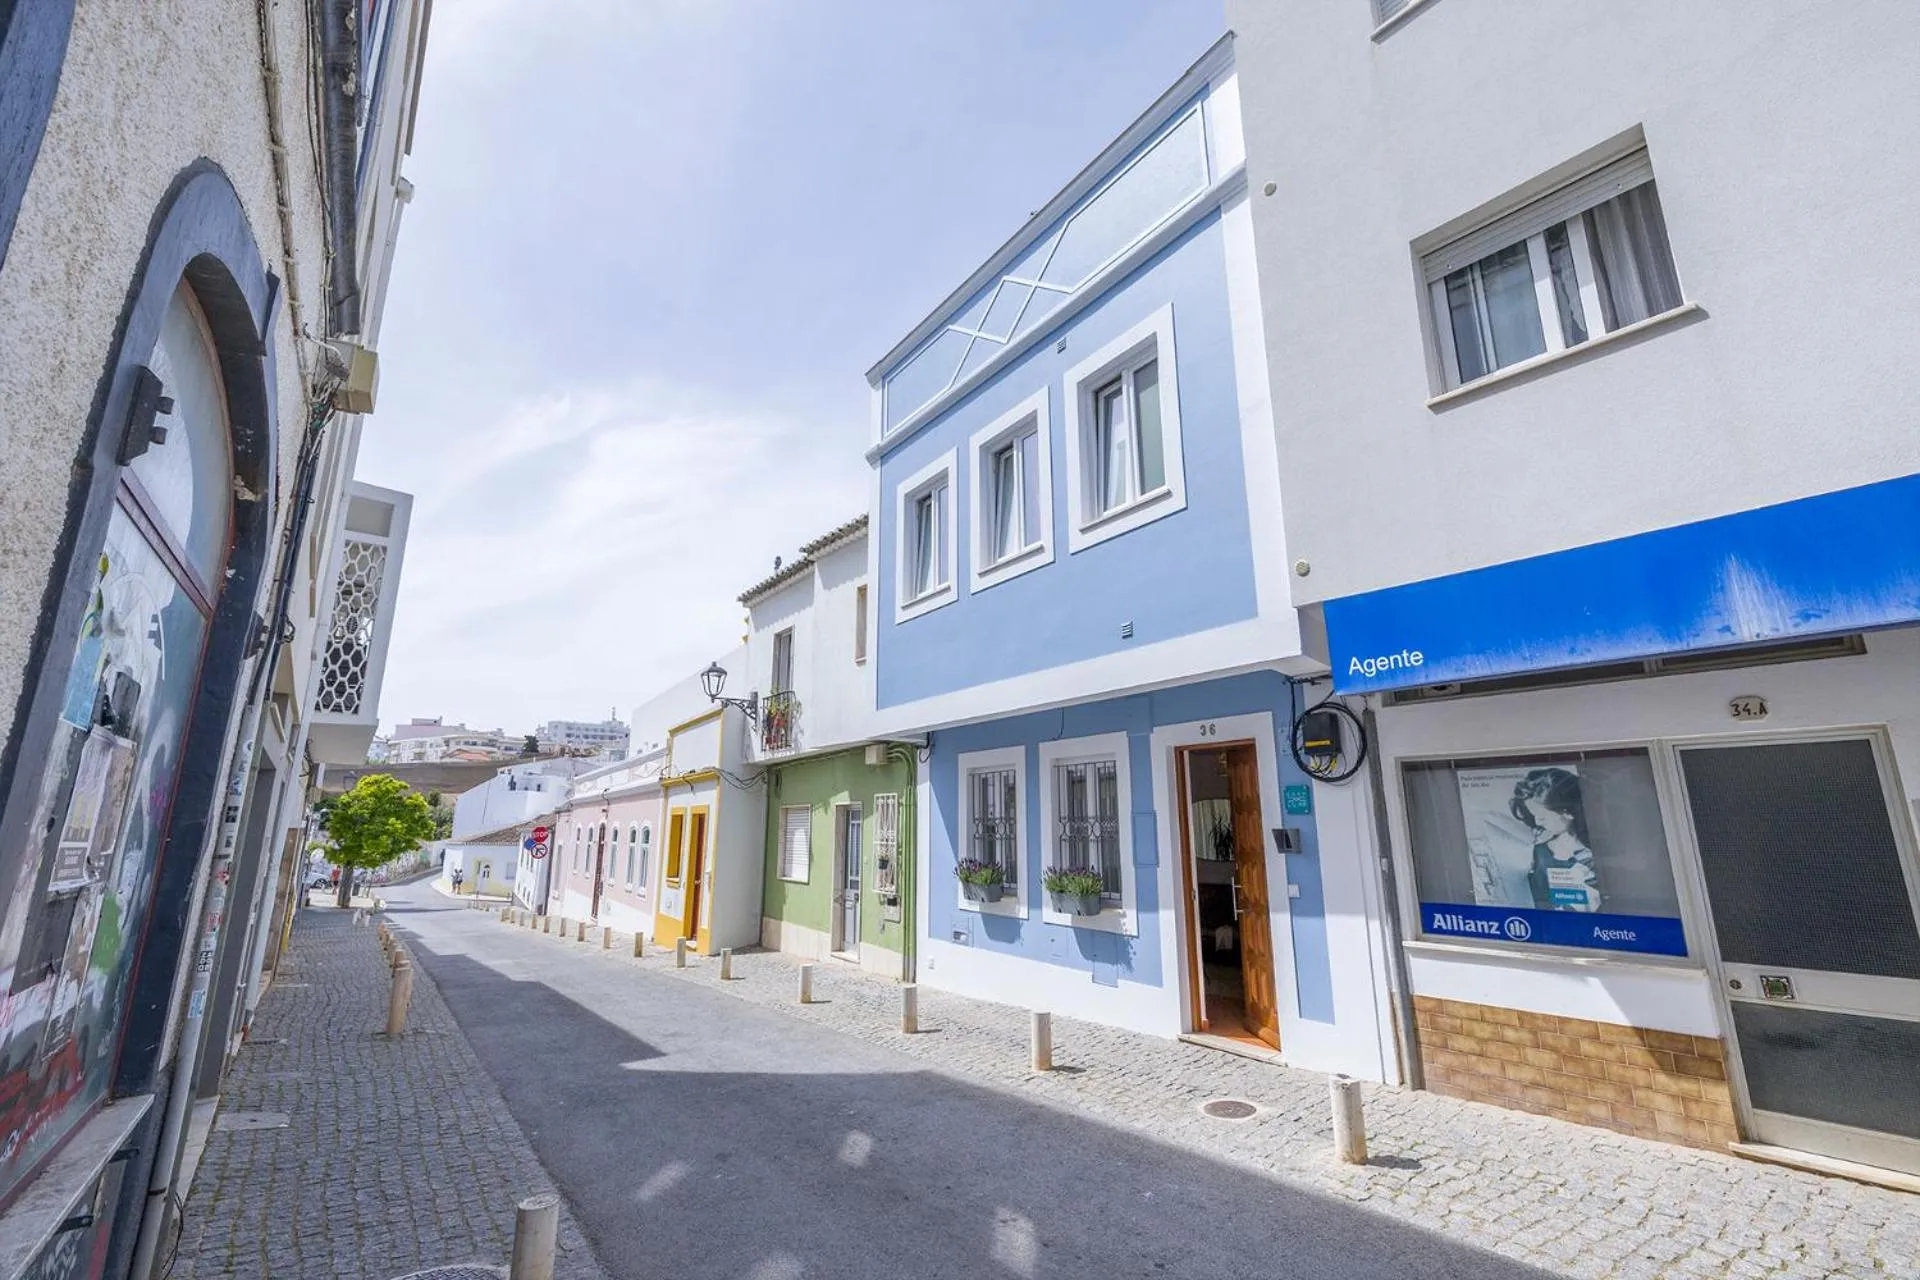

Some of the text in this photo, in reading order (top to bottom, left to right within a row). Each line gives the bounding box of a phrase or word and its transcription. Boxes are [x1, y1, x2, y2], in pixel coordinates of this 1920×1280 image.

[1348, 648, 1424, 677] Agente
[1200, 723, 1216, 736] 36
[1433, 913, 1501, 935] Allianz
[1593, 926, 1637, 942] Agente
